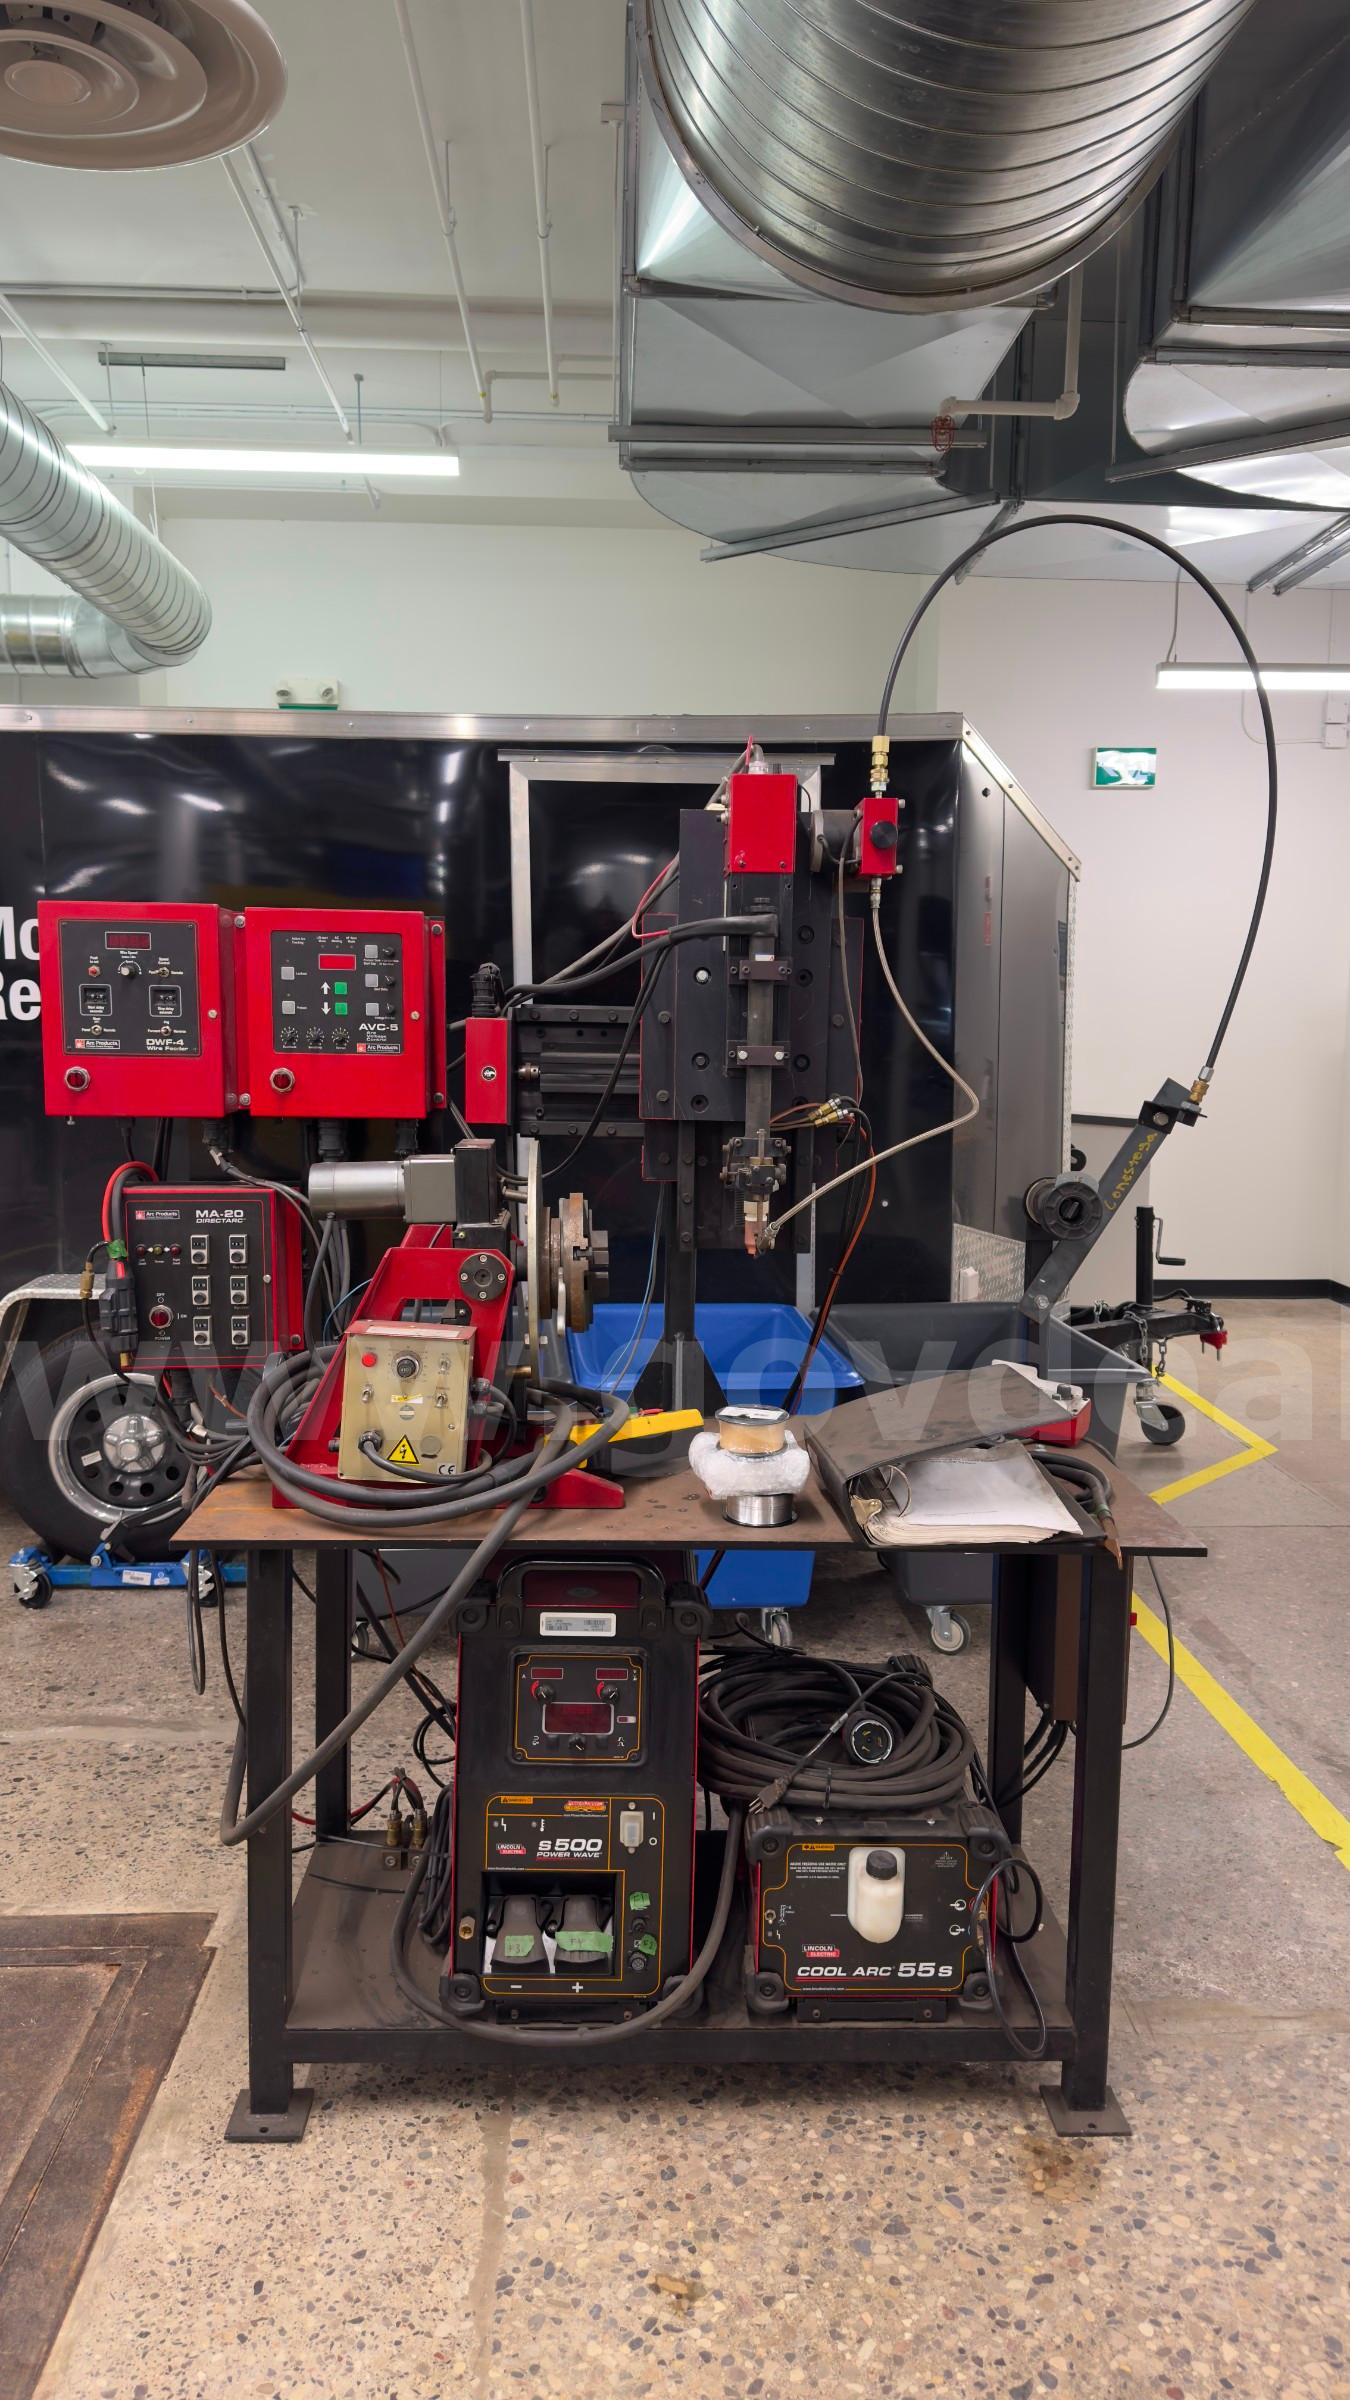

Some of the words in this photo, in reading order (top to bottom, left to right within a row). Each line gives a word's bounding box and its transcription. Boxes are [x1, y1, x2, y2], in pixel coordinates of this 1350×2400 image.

[0, 971, 41, 1021] e
[146, 1038, 184, 1046] DWF-4
[797, 1966, 846, 1976] COOL
[852, 1966, 892, 1976] ARC
